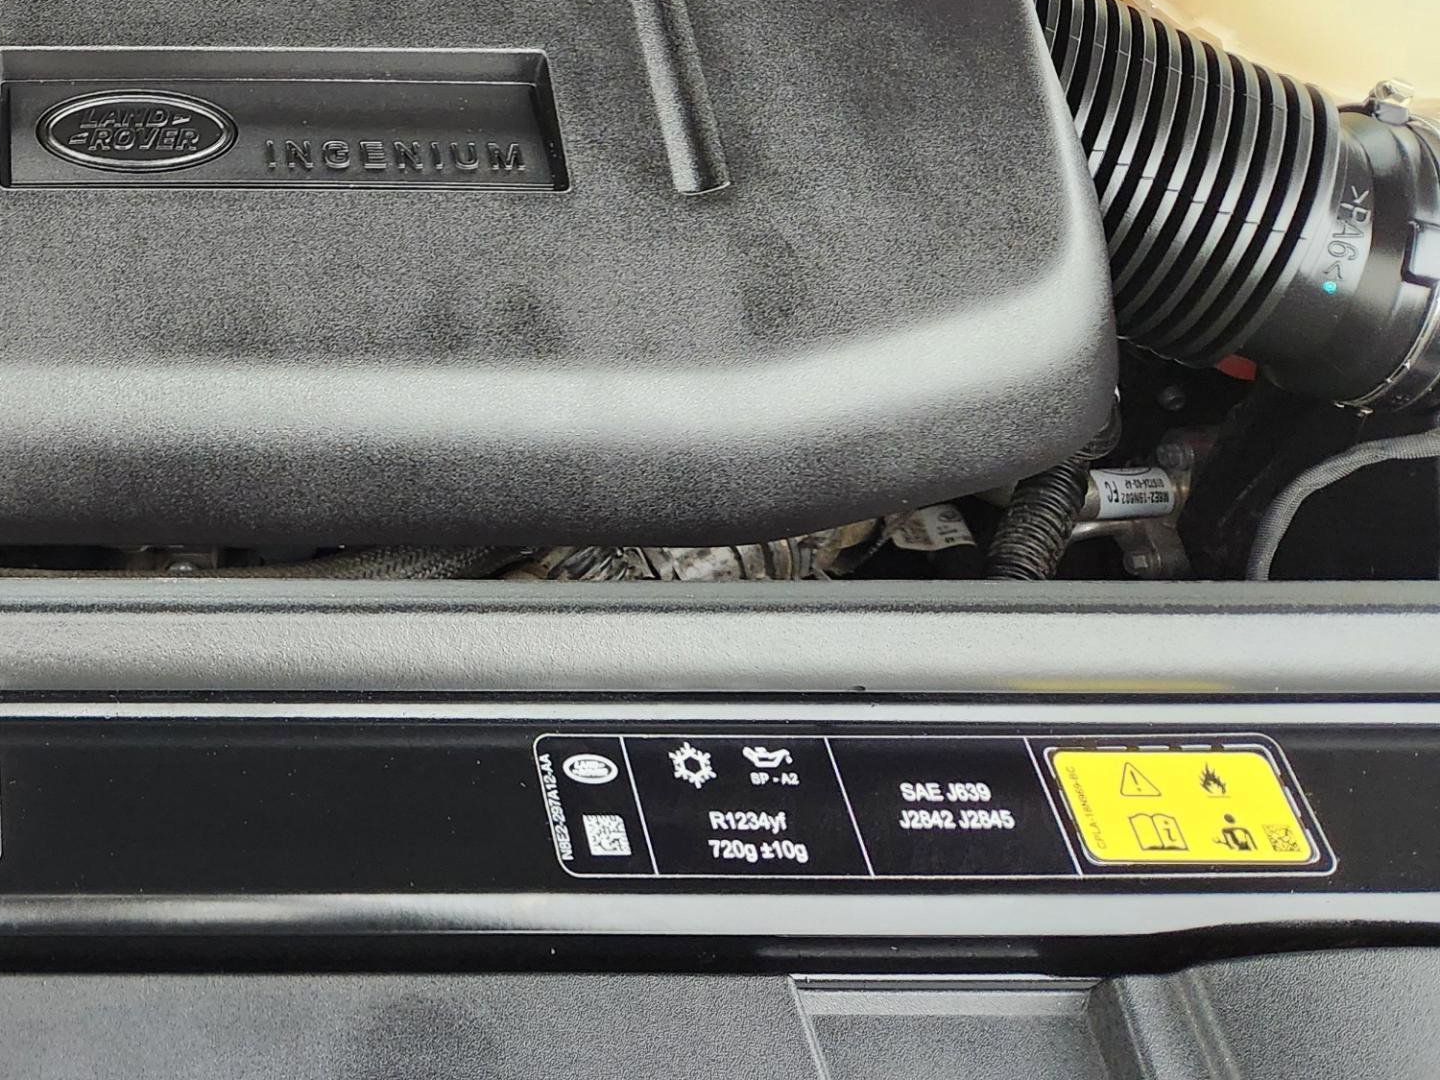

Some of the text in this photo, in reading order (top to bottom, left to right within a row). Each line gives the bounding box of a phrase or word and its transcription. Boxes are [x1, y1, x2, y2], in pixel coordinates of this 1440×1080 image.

[80, 107, 170, 129] LAND
[88, 128, 201, 151] ROVER
[265, 139, 527, 171] INGENIUM
[899, 782, 992, 802] SAE J639
[708, 811, 788, 835] R1234yf
[899, 809, 1016, 830] J2842 J2845
[707, 839, 810, 864] 720g ±10g
